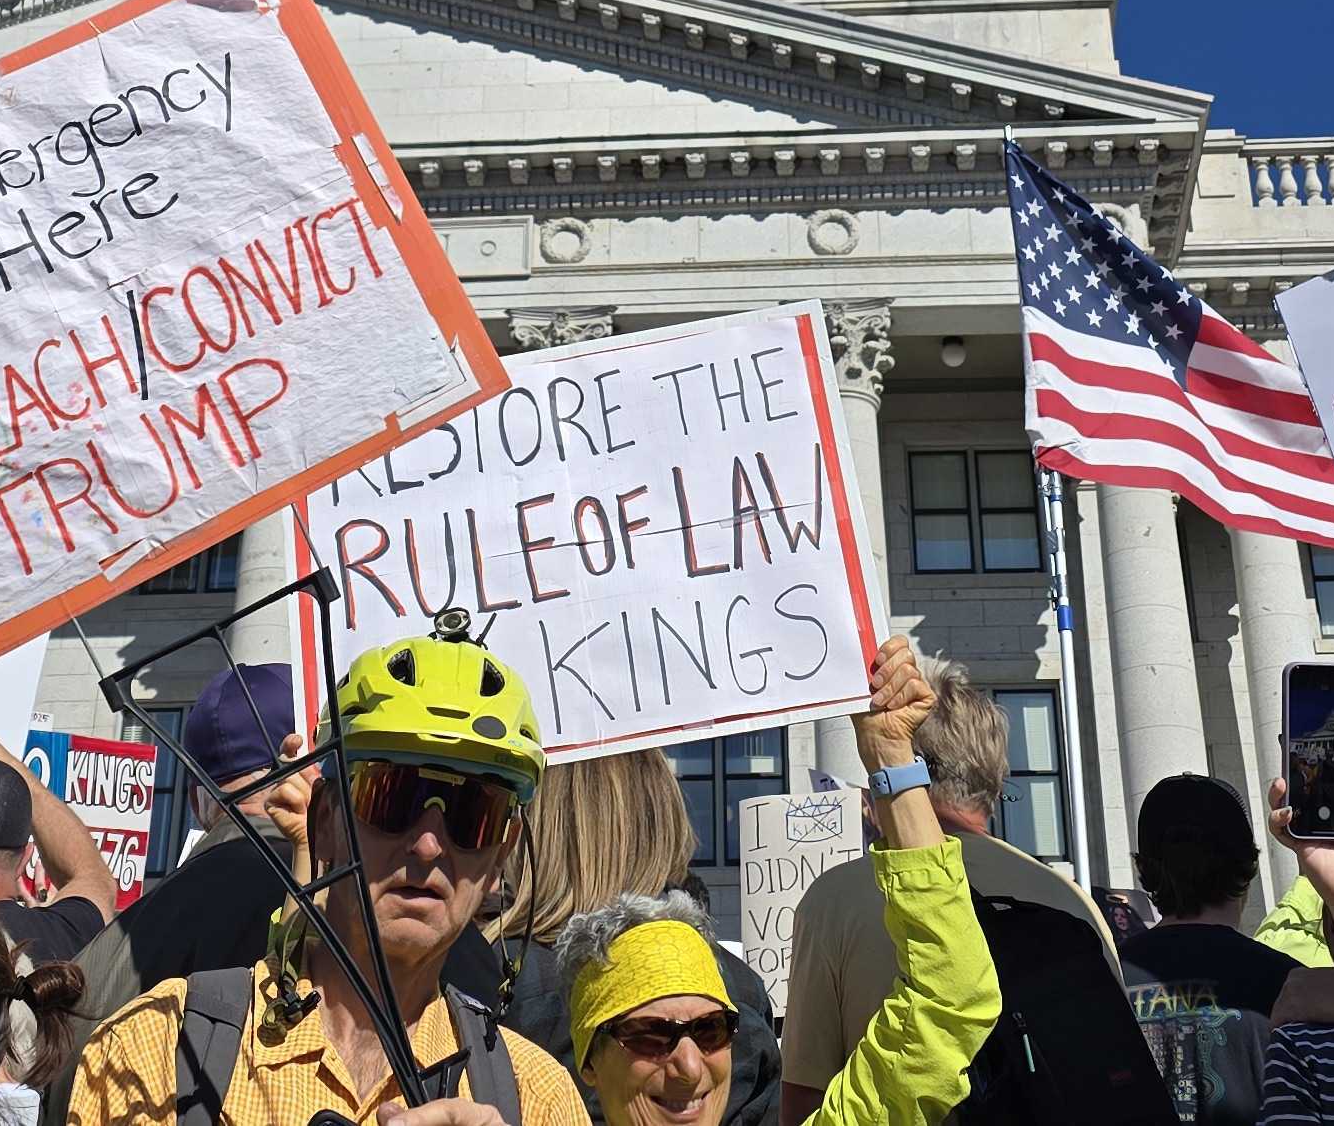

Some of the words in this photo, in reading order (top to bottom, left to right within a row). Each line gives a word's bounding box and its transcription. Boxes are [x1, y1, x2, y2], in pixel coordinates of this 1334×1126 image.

[653, 346, 798, 435] THE
[673, 444, 823, 577] LAW
[539, 582, 828, 735] KINGS
[64, 749, 152, 814] KINGS
[747, 802, 769, 852] I
[792, 819, 838, 837] KING
